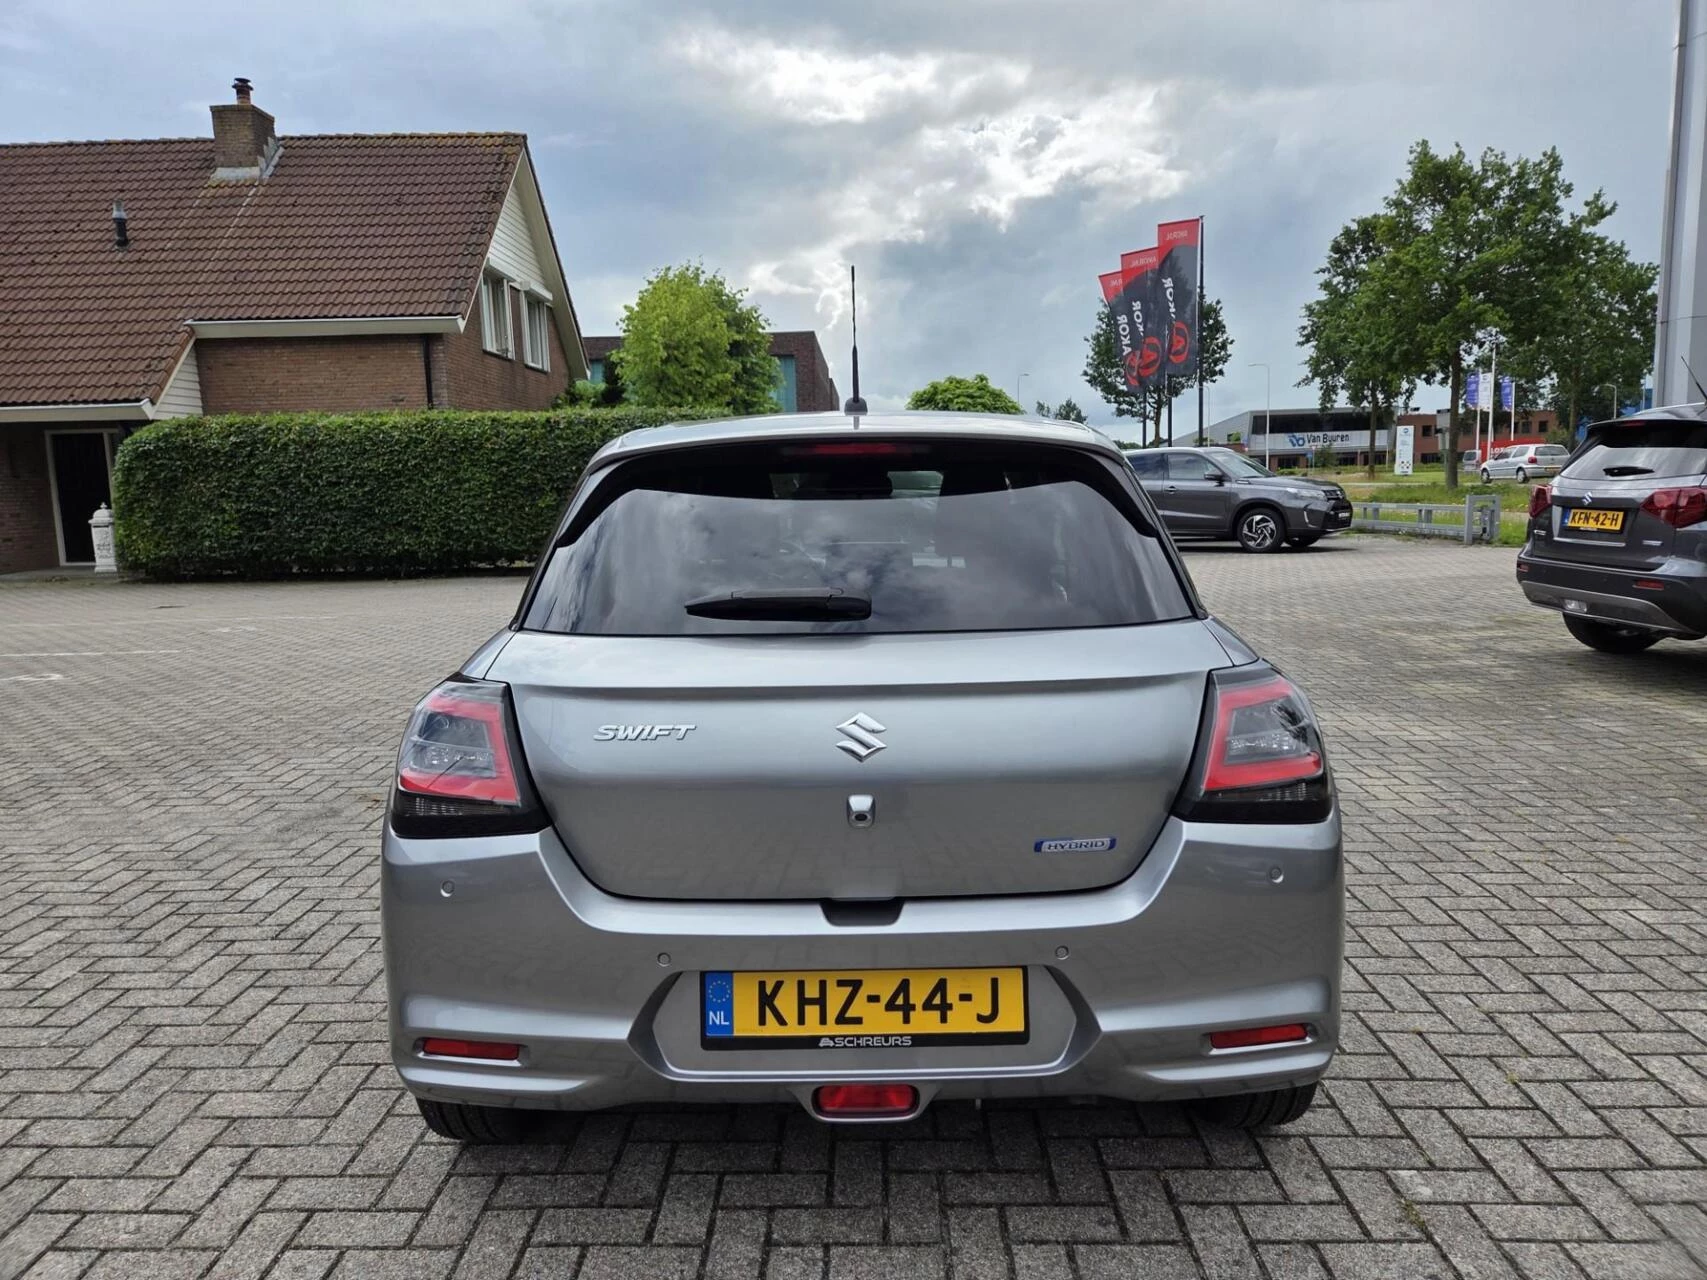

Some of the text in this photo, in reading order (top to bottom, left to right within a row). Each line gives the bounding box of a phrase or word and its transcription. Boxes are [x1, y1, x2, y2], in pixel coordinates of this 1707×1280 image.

[1306, 434, 1320, 443] Van
[1570, 511, 1620, 527] KFN-42-H
[593, 724, 697, 741] SWIFT
[1047, 840, 1105, 851] HYBRID
[757, 977, 1000, 1027] KHZ-44-J
[708, 1011, 730, 1026] NL
[834, 1036, 912, 1048] SCHREURS
